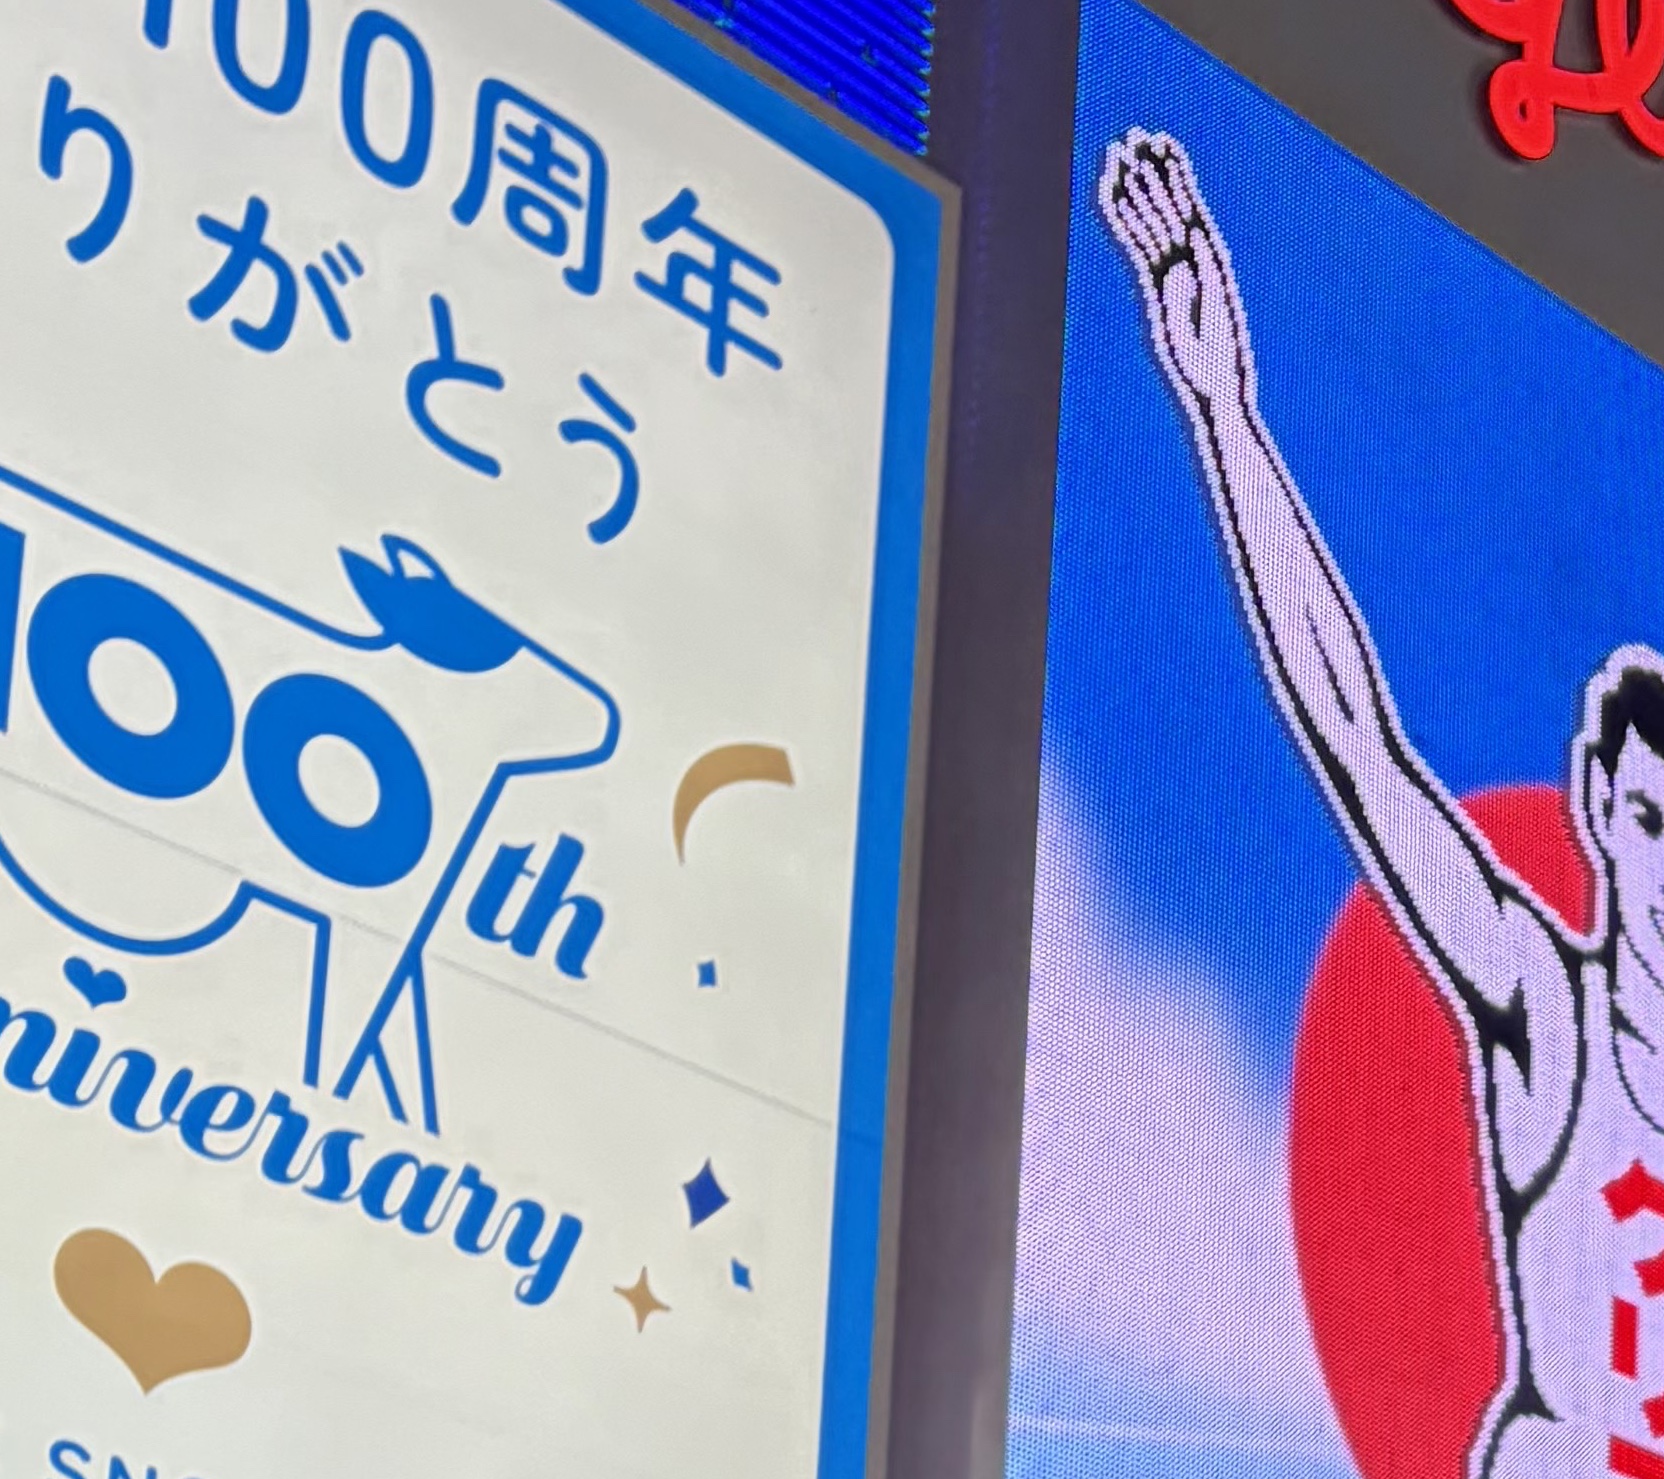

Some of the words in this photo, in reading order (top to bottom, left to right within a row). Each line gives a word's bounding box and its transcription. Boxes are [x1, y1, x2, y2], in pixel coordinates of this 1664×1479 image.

[40, 75, 640, 543] りがとう
[144, 0, 783, 375] 00周年
